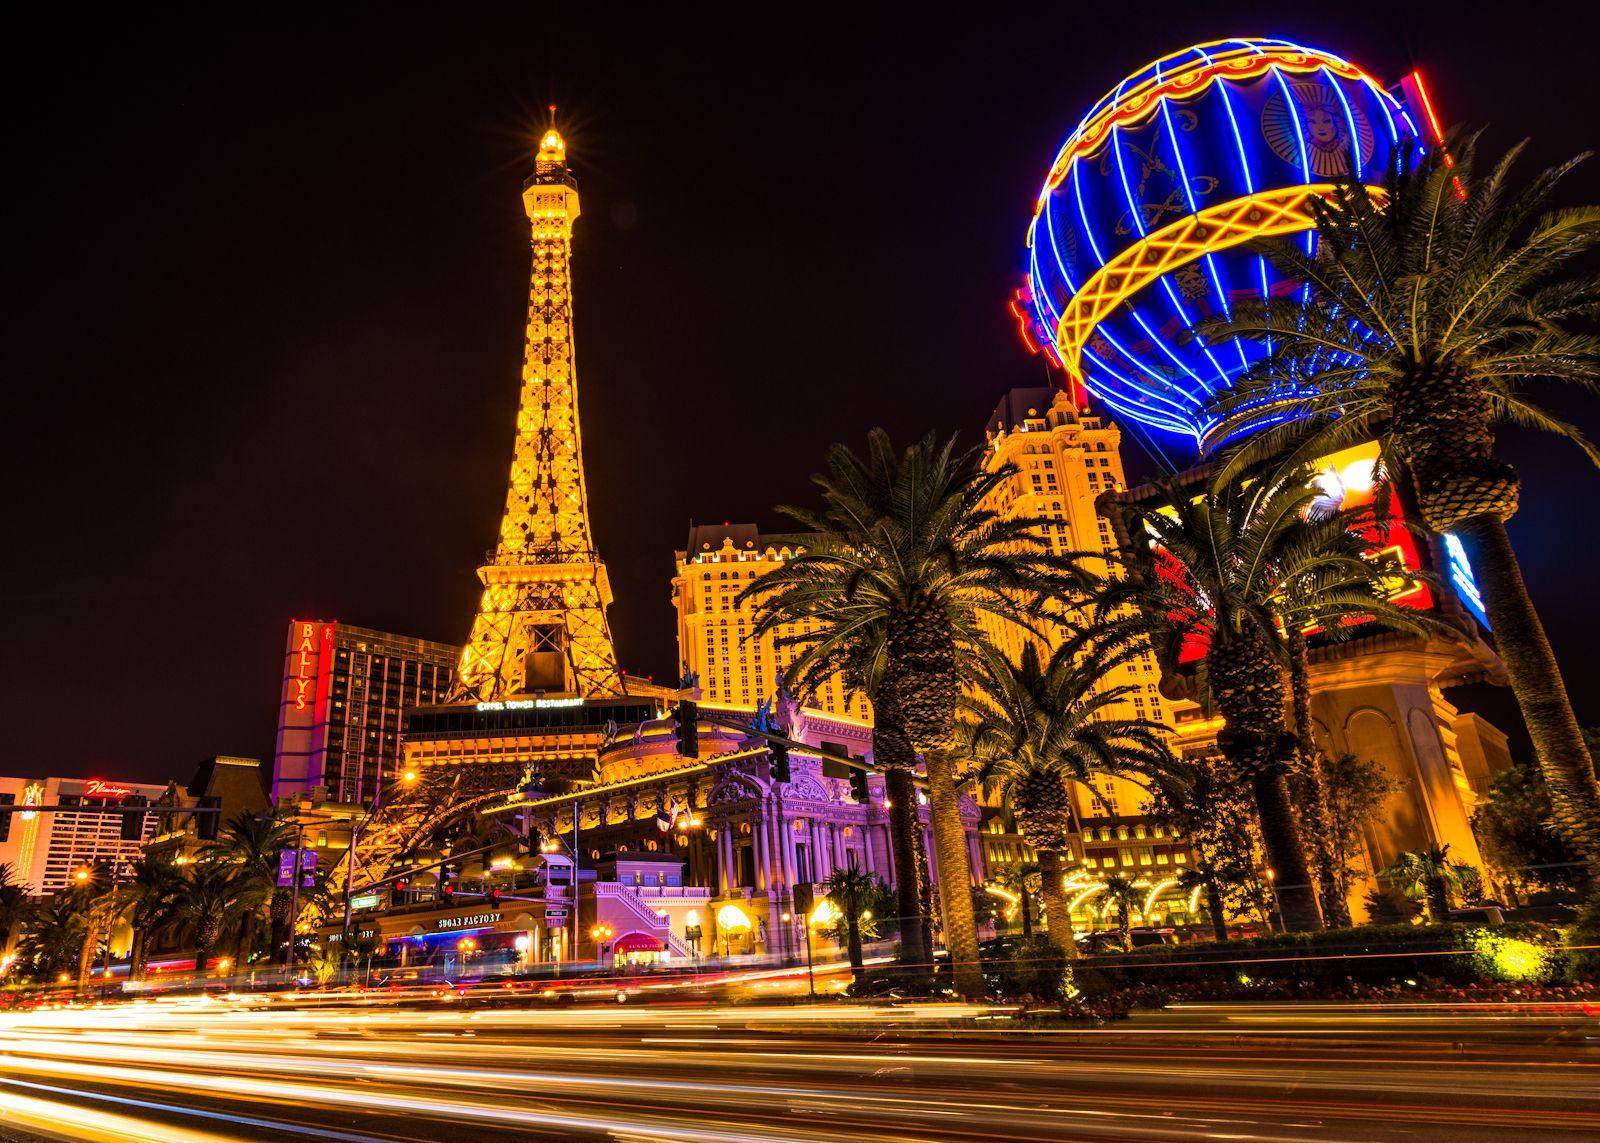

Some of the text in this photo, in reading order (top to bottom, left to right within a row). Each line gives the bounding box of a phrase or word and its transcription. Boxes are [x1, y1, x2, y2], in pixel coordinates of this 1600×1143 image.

[505, 700, 533, 710] TOWER
[536, 698, 584, 708] RESTAURANT
[438, 913, 500, 928] SUGAR FACTORY
